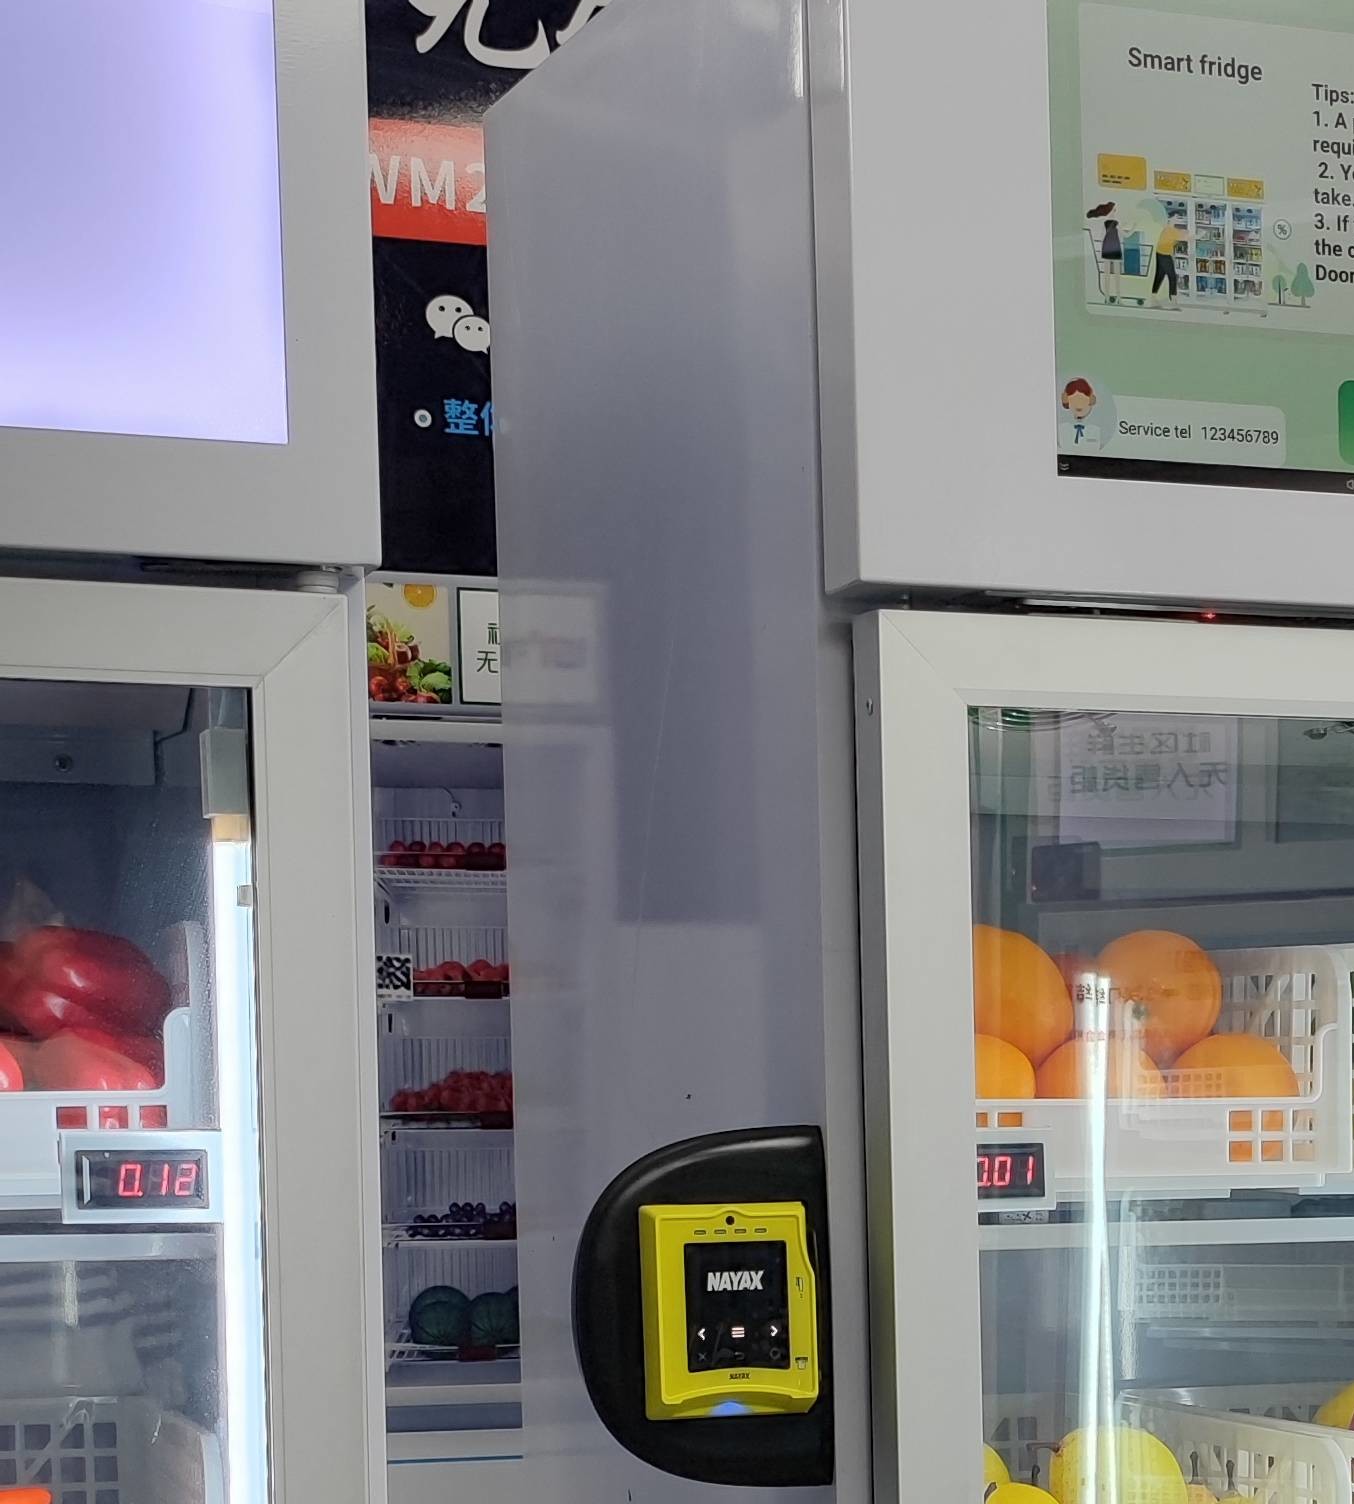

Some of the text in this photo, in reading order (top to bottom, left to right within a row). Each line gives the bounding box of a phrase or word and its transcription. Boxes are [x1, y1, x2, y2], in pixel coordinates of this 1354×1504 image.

[1127, 46, 1263, 85] Smart fridge
[1311, 83, 1354, 106] Tips:
[1312, 110, 1329, 127] 1.
[1334, 112, 1347, 129] A
[1317, 161, 1334, 179] 2.
[1314, 212, 1330, 231] 3.
[1336, 214, 1350, 232] If
[1314, 238, 1343, 257] the
[1118, 420, 1279, 445] Service tel 123456789
[707, 1269, 766, 1292] NAYAX
